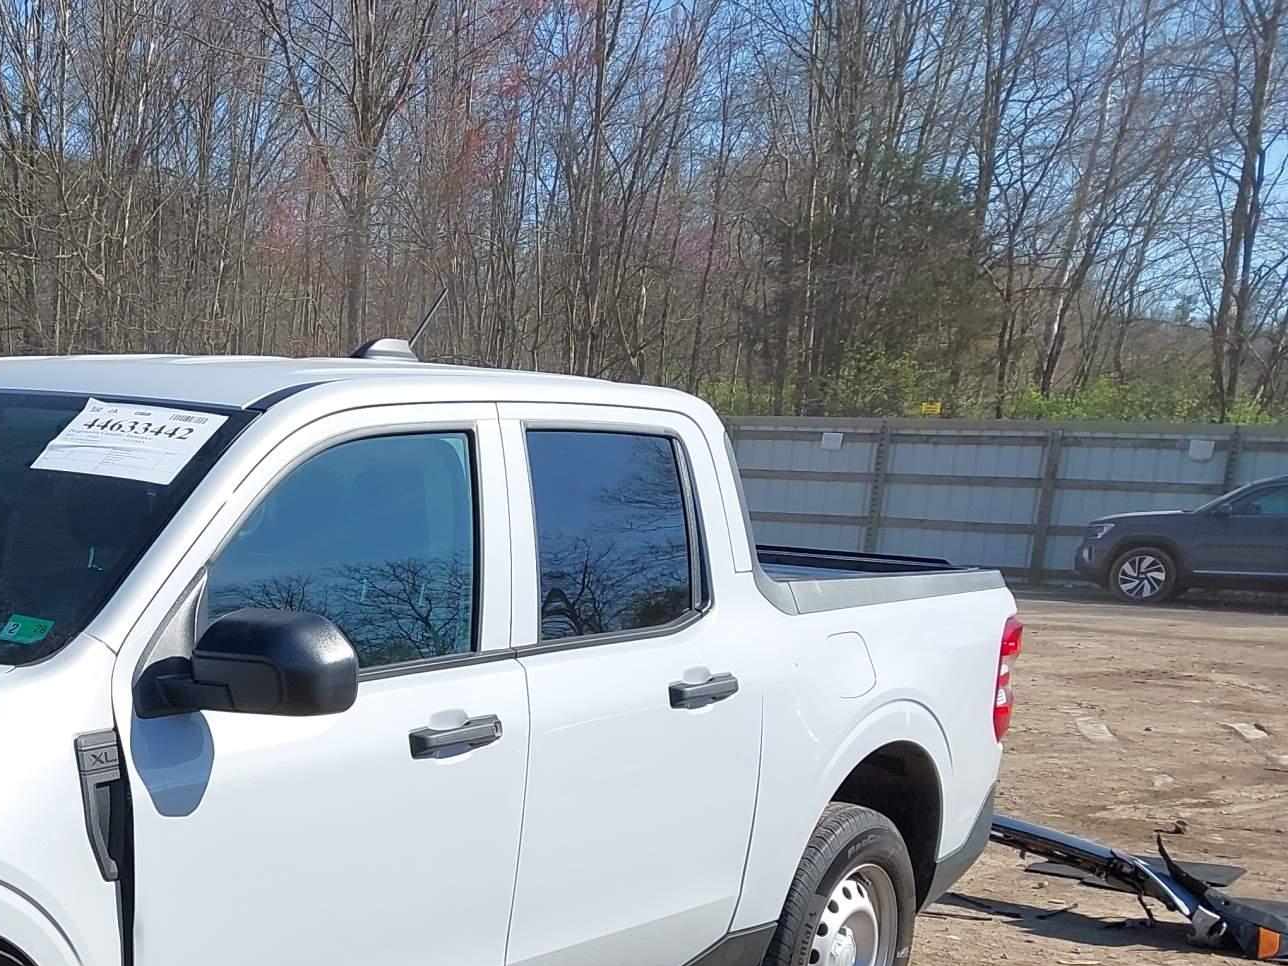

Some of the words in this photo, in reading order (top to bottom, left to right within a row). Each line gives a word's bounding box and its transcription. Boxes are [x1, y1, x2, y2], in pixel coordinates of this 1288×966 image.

[83, 418, 194, 440] 44633442
[7, 623, 20, 634] 2
[91, 752, 117, 766] XL
